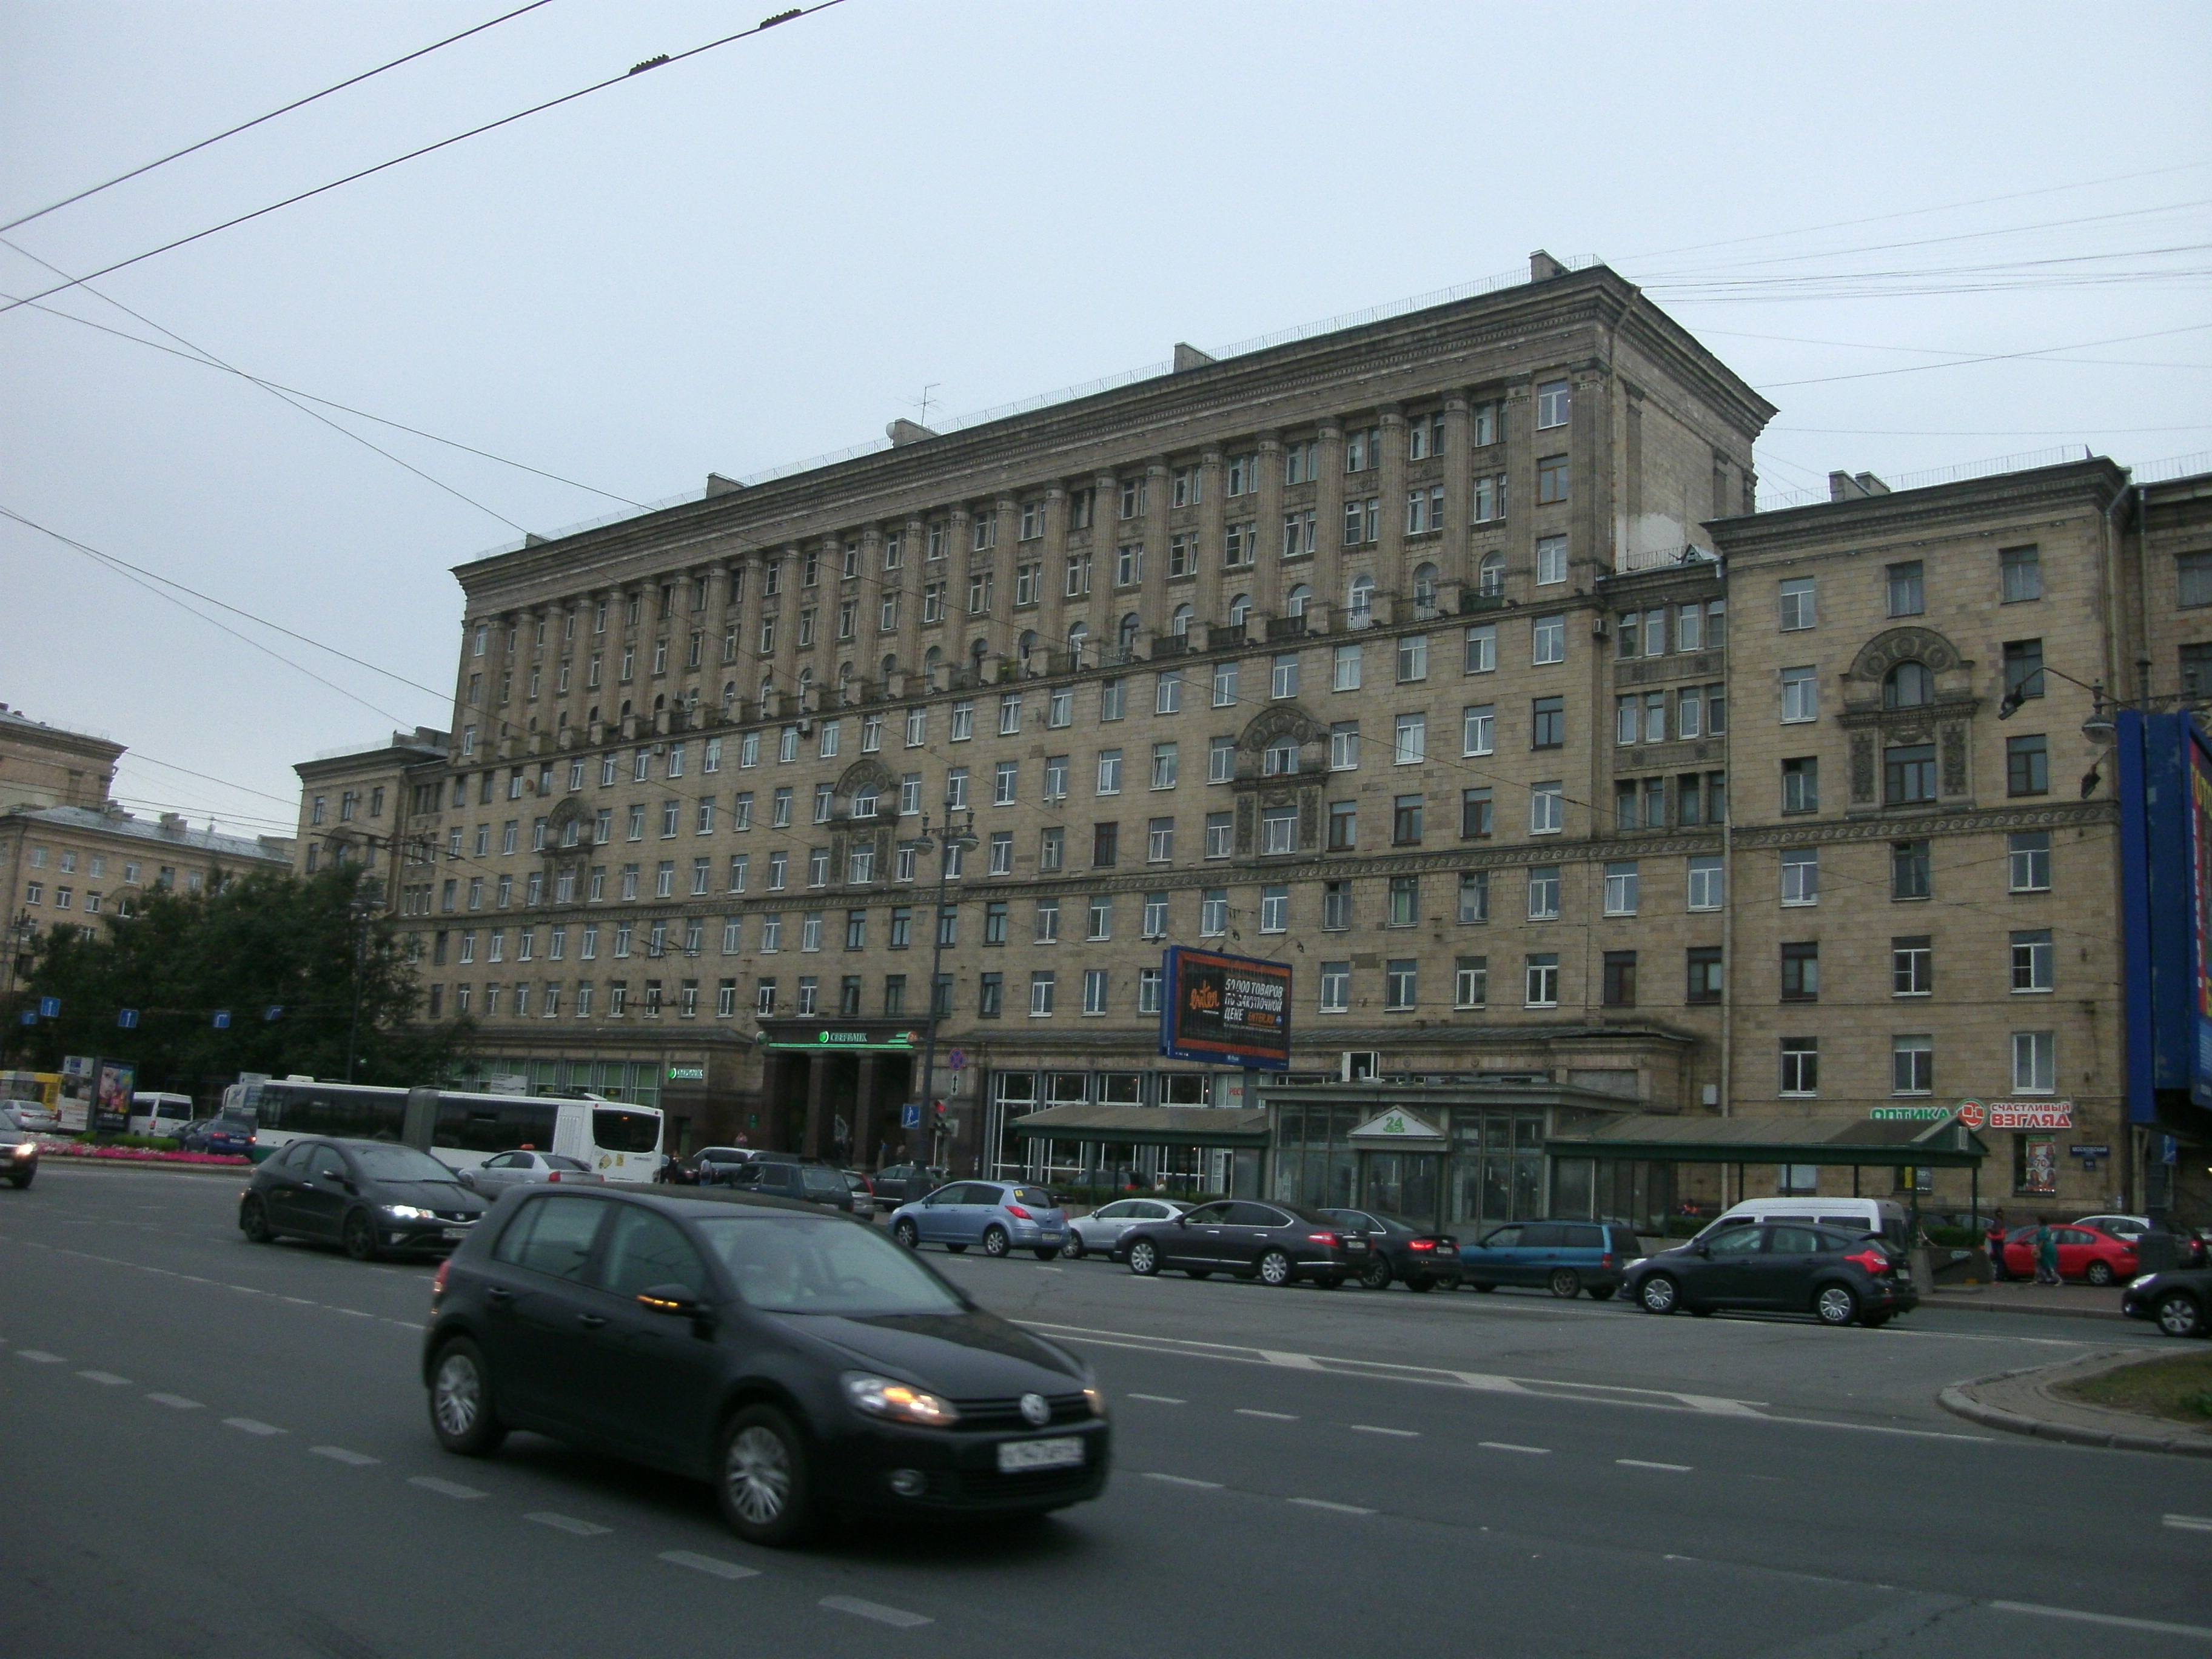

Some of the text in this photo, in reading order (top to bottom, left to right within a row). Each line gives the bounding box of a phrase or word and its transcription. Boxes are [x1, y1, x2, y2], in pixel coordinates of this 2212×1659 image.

[1252, 982, 1283, 998] ТОВАРОВ
[1224, 1007, 1244, 1021] ЦЕНЕ
[1386, 1116, 1403, 1128] 24
[1991, 1113, 2071, 1127] ВЗГЛЯД
